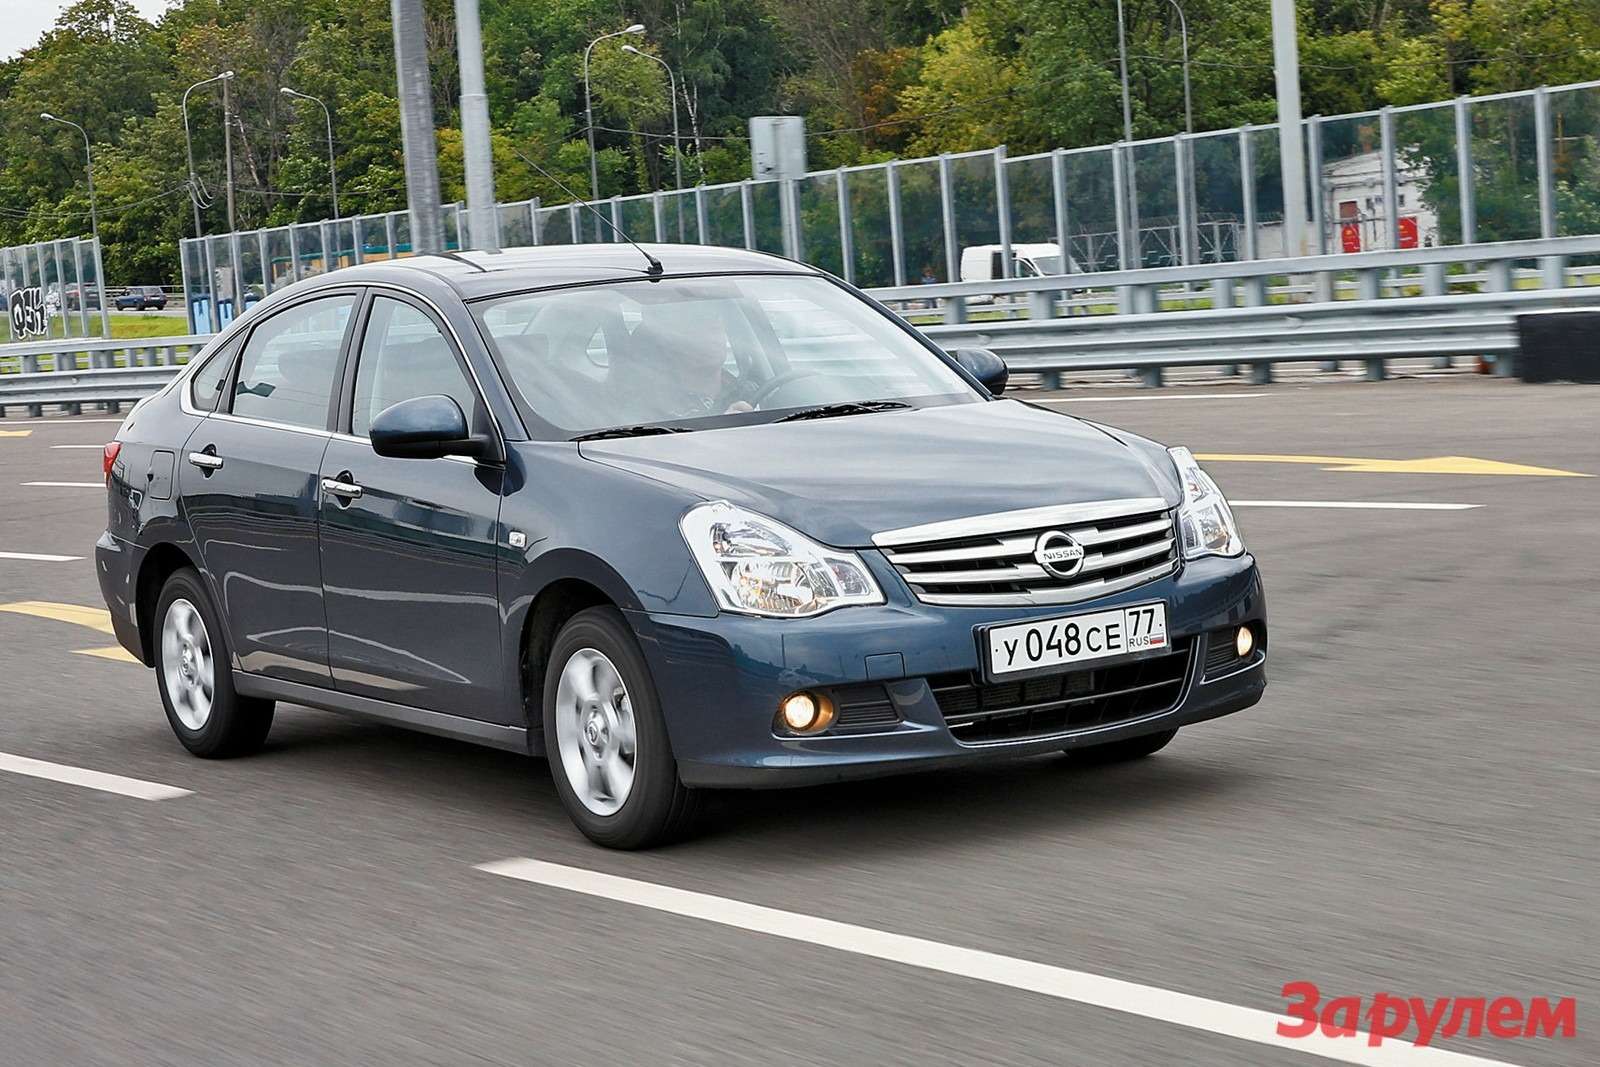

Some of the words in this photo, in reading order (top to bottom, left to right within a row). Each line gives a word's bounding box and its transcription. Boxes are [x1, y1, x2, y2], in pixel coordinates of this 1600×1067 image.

[1043, 549, 1082, 560] NISSAN
[1128, 608, 1155, 636] 77
[1129, 636, 1150, 647] RUS
